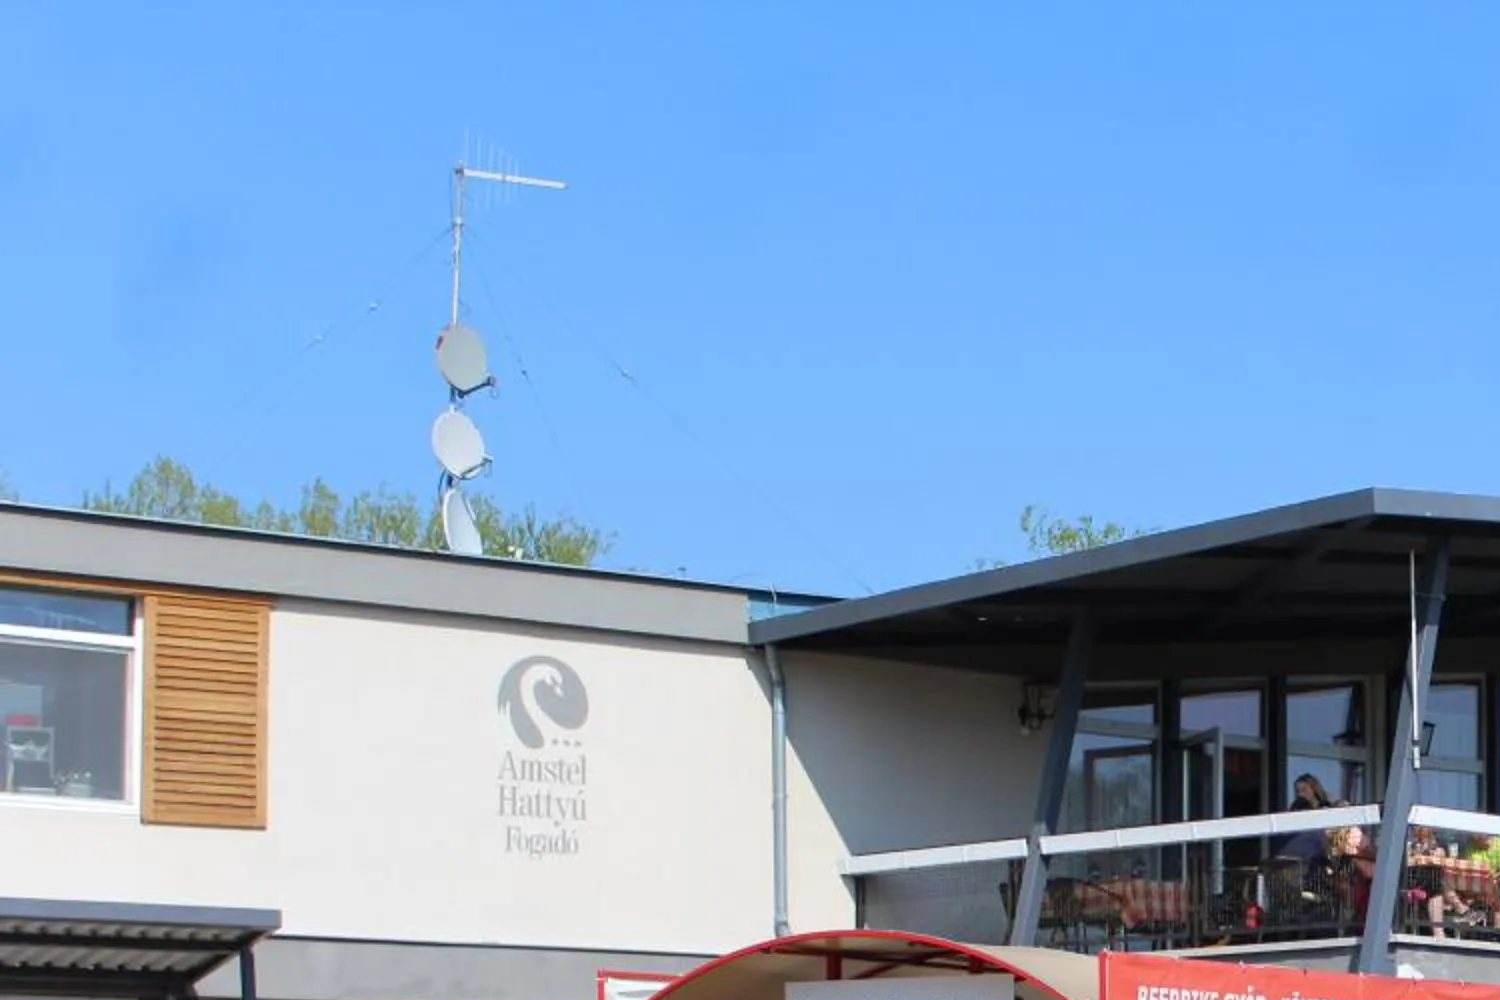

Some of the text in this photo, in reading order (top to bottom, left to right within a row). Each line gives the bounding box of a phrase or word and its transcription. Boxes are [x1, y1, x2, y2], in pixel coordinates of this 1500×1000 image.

[497, 751, 587, 785] Amstel
[496, 783, 588, 828] Hattyú
[504, 825, 580, 861] Fogadó
